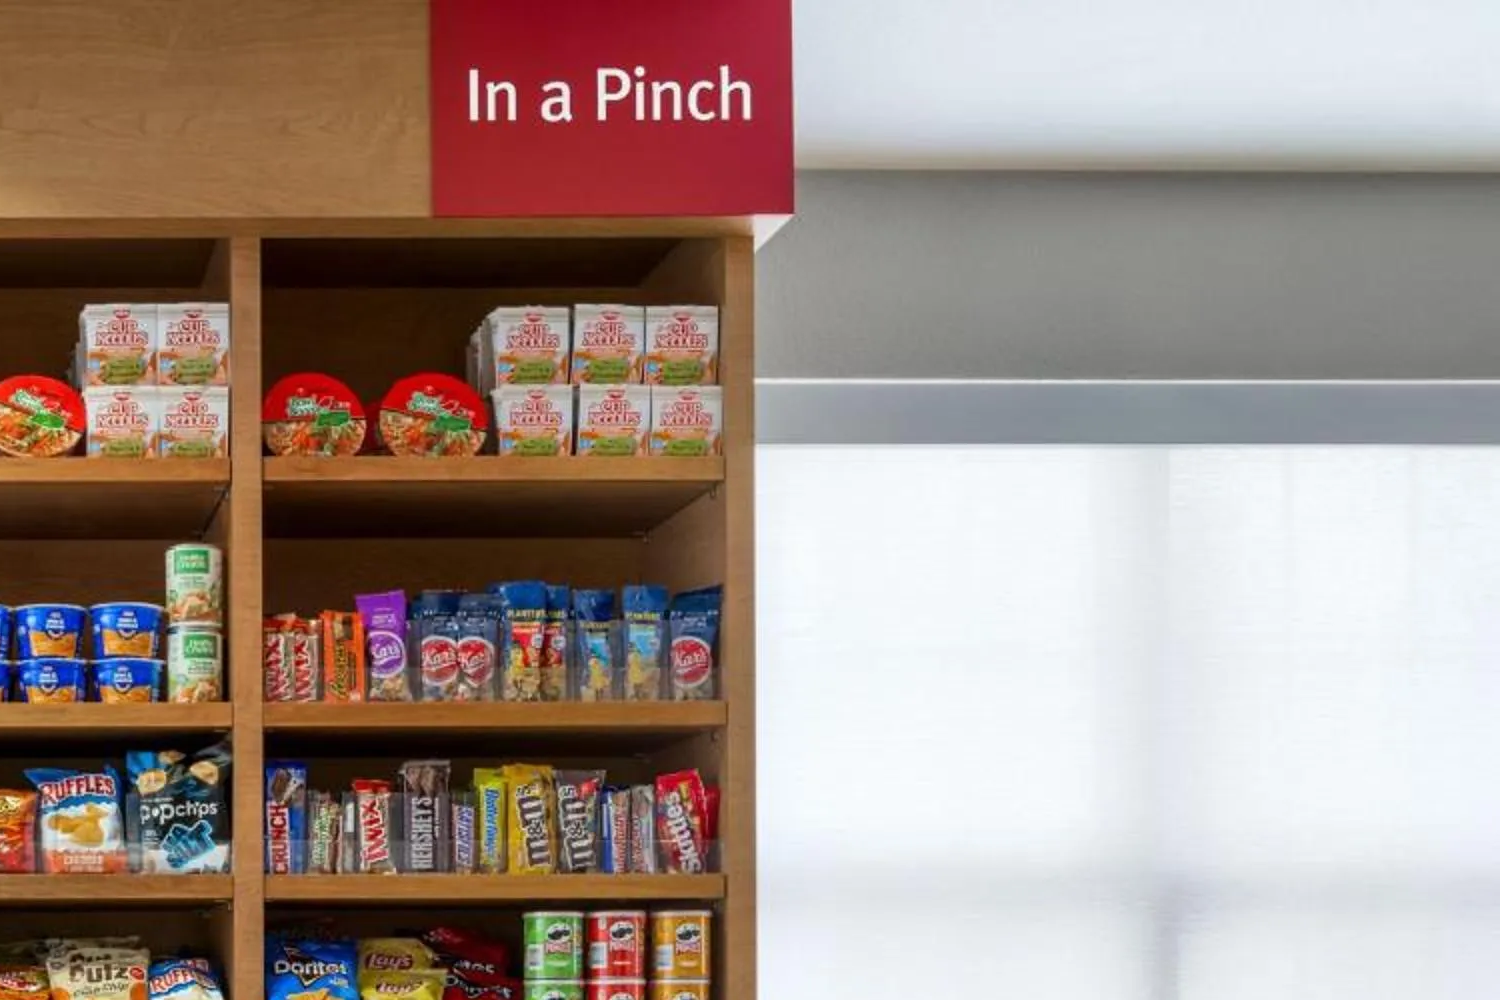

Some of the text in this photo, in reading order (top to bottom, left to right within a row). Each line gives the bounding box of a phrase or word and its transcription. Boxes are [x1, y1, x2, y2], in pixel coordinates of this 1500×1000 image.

[468, 65, 752, 122] In a Pinch
[41, 774, 116, 805] RUFFLES
[269, 803, 289, 874] CRUNCH
[361, 799, 391, 863] TWIX
[274, 959, 348, 976] Doritos
